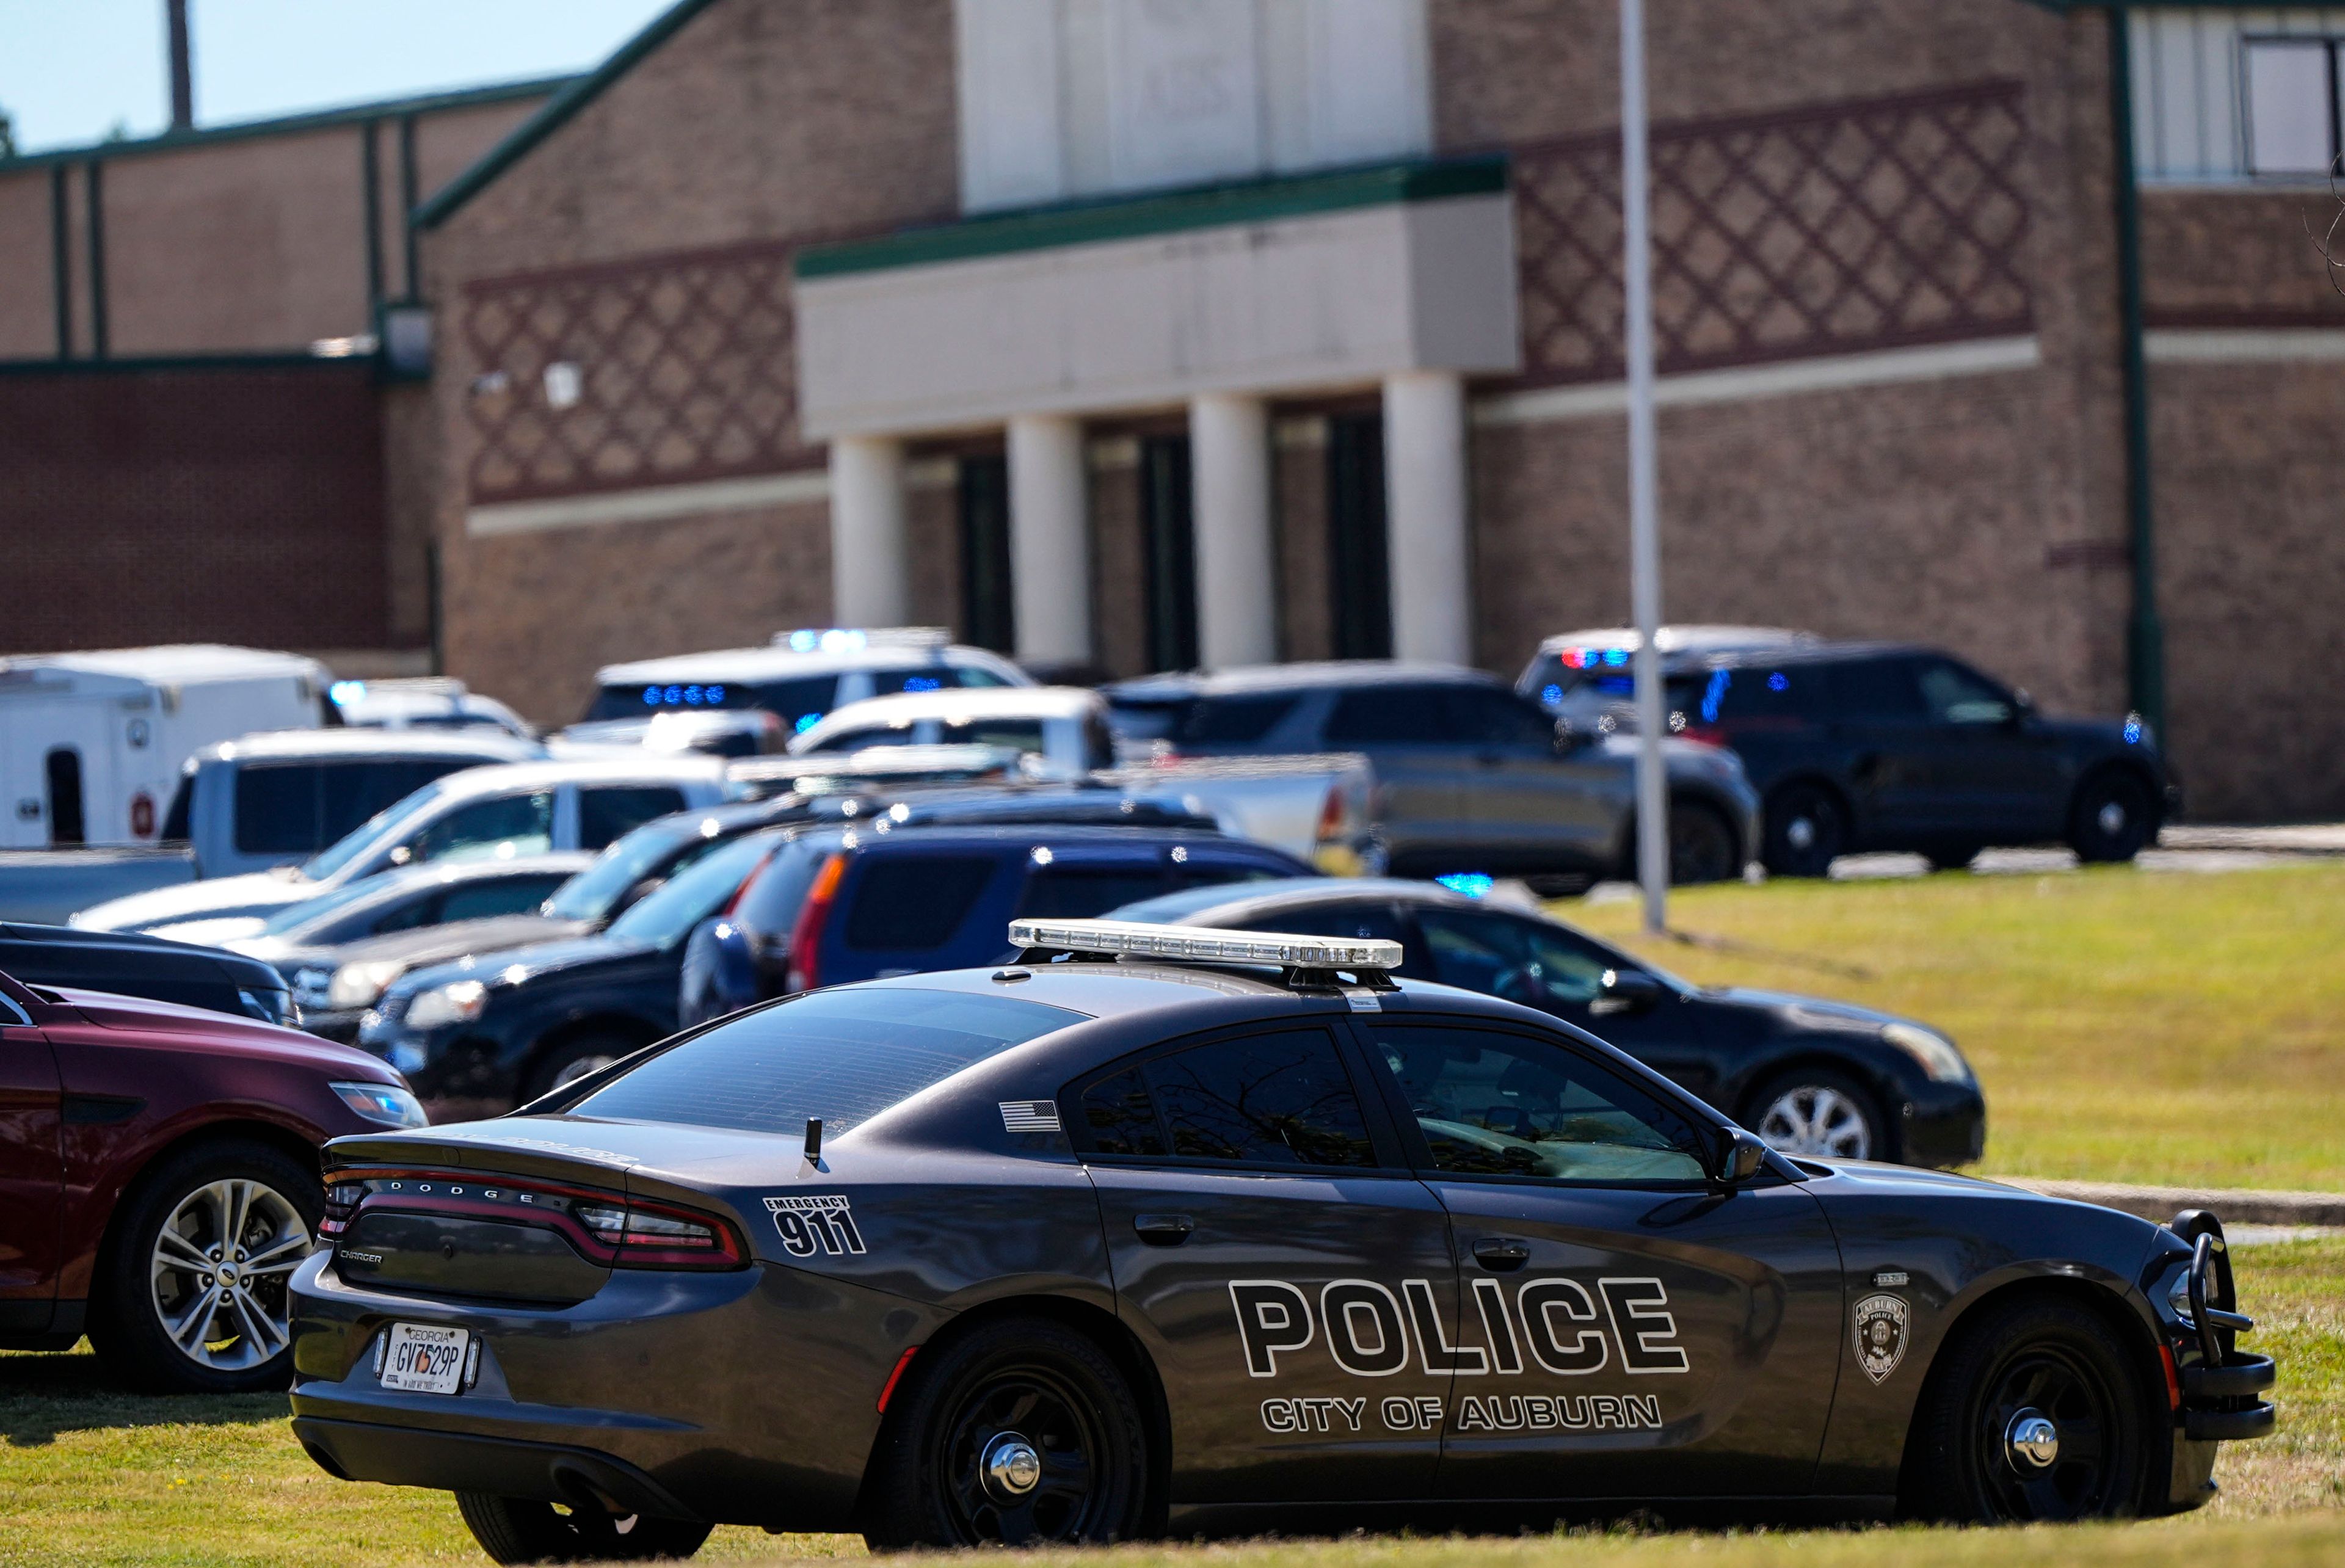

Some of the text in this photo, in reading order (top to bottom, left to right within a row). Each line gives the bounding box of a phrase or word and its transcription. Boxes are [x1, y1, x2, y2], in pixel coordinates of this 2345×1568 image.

[391, 1181, 534, 1203] DODGE
[762, 1195, 850, 1211] EMERGENCY
[773, 1208, 867, 1257] 911
[340, 1249, 383, 1264] CHARGER
[1864, 1299, 1897, 1312] AUBURN
[1870, 1312, 1892, 1320] POLICE
[409, 1329, 449, 1343] GEORGIA
[1228, 1277, 1690, 1377] POLICE
[397, 1342, 458, 1376] GV7529P
[1260, 1395, 1663, 1432] CITY OF AUBURN
